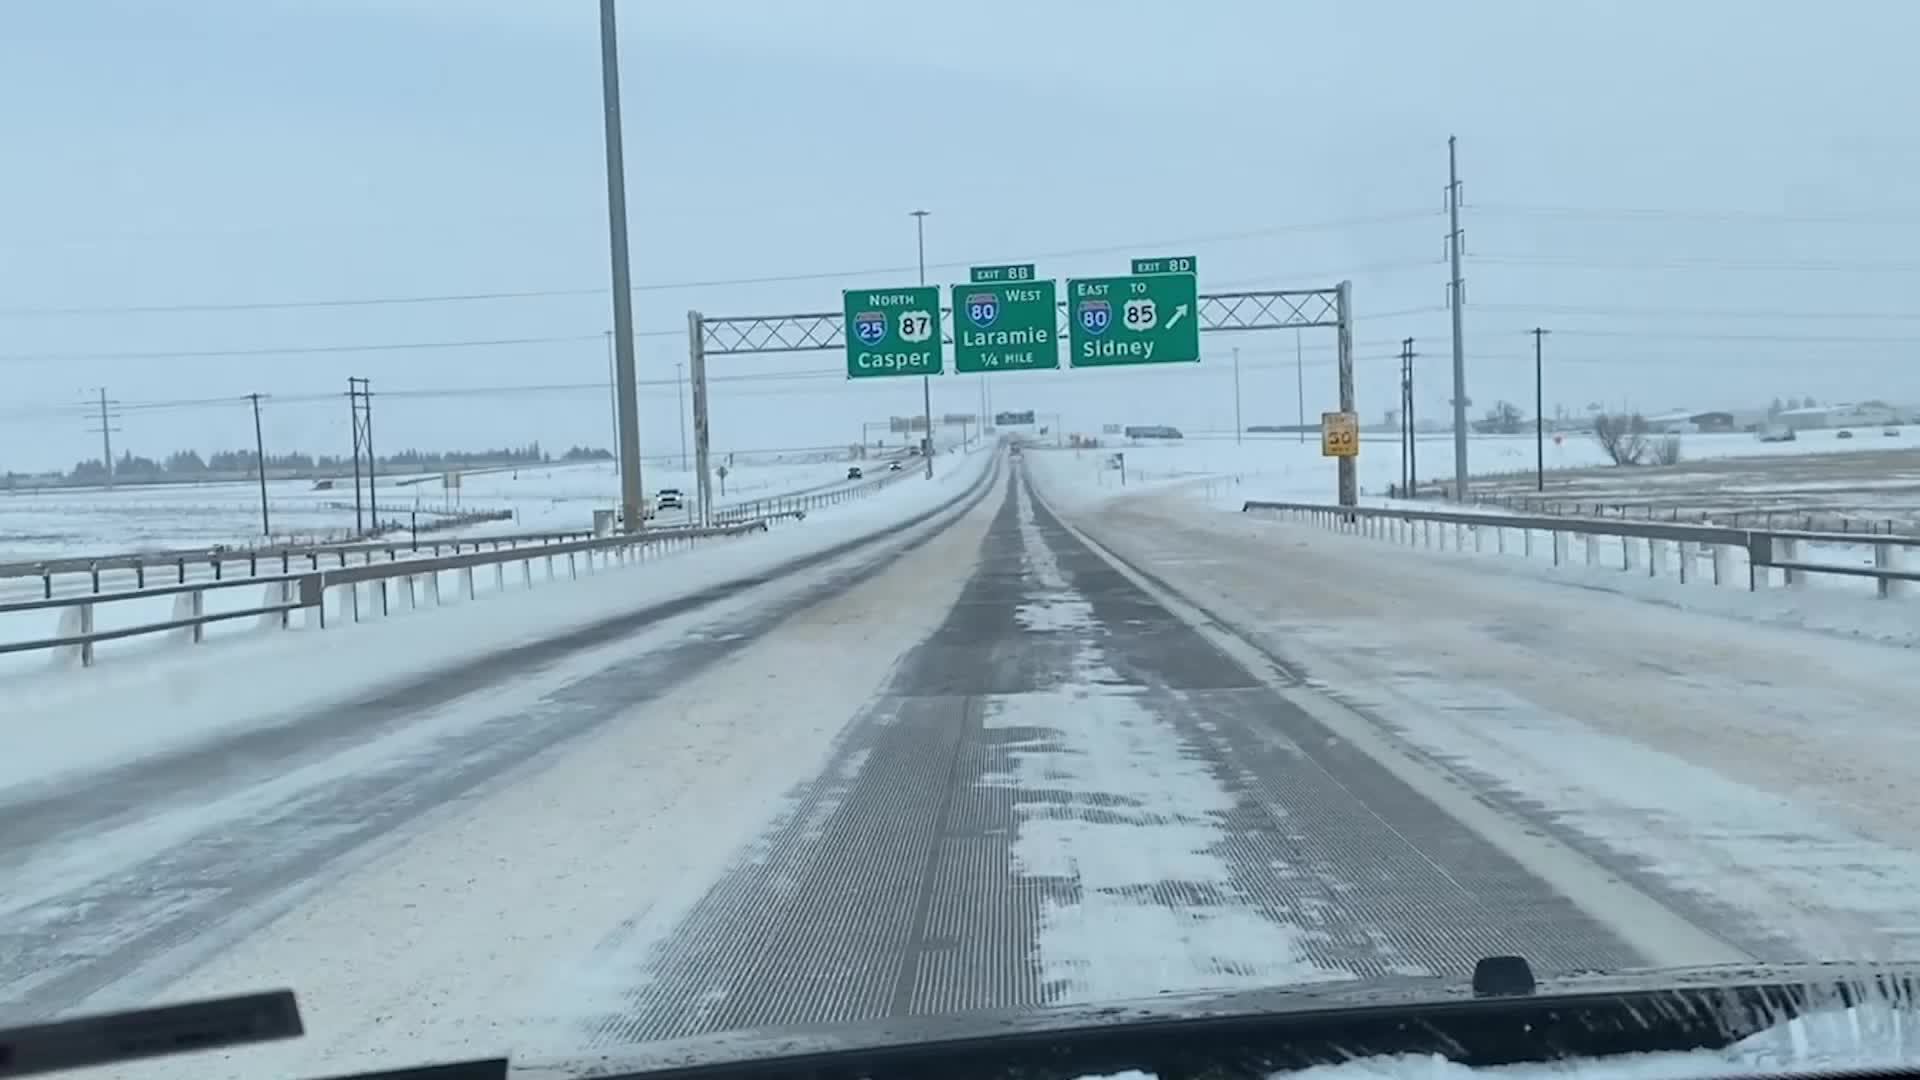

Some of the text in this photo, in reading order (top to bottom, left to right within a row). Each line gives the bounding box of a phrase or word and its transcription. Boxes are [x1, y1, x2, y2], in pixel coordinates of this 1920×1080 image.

[976, 267, 1028, 280] EXIT 8B
[1137, 259, 1190, 273] EXIT 8D
[1005, 289, 1041, 302] WEST
[1078, 283, 1147, 296] EAST TO
[869, 294, 914, 306] NORTH
[971, 304, 994, 320] 80
[1083, 311, 1107, 327] 80
[1127, 305, 1153, 323] 85
[860, 322, 882, 338] 25
[903, 317, 928, 335] 87
[963, 326, 1048, 347] Laramie
[1005, 352, 1034, 363] MILE
[1083, 340, 1154, 359] Sidney
[858, 351, 930, 371] Casper
